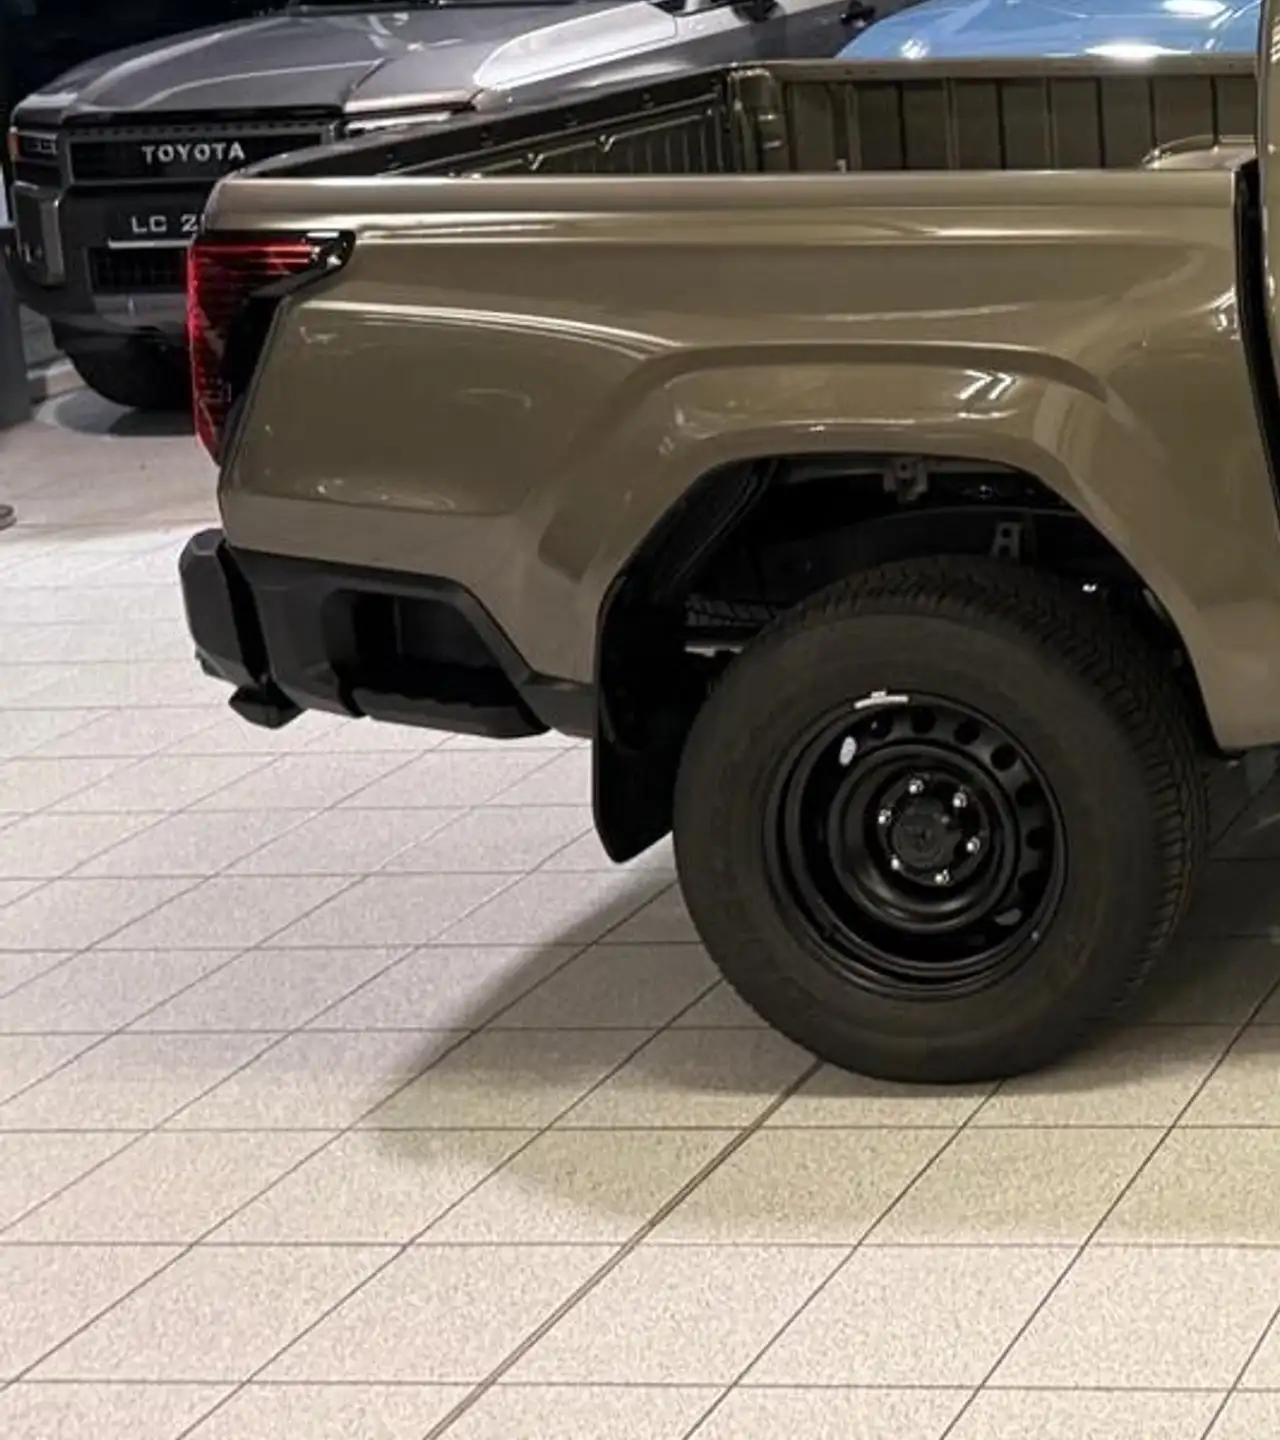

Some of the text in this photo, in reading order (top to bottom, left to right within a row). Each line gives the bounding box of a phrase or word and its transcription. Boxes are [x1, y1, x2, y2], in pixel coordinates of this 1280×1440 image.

[142, 142, 245, 163] TOYOTA
[131, 213, 205, 233] LC 2
